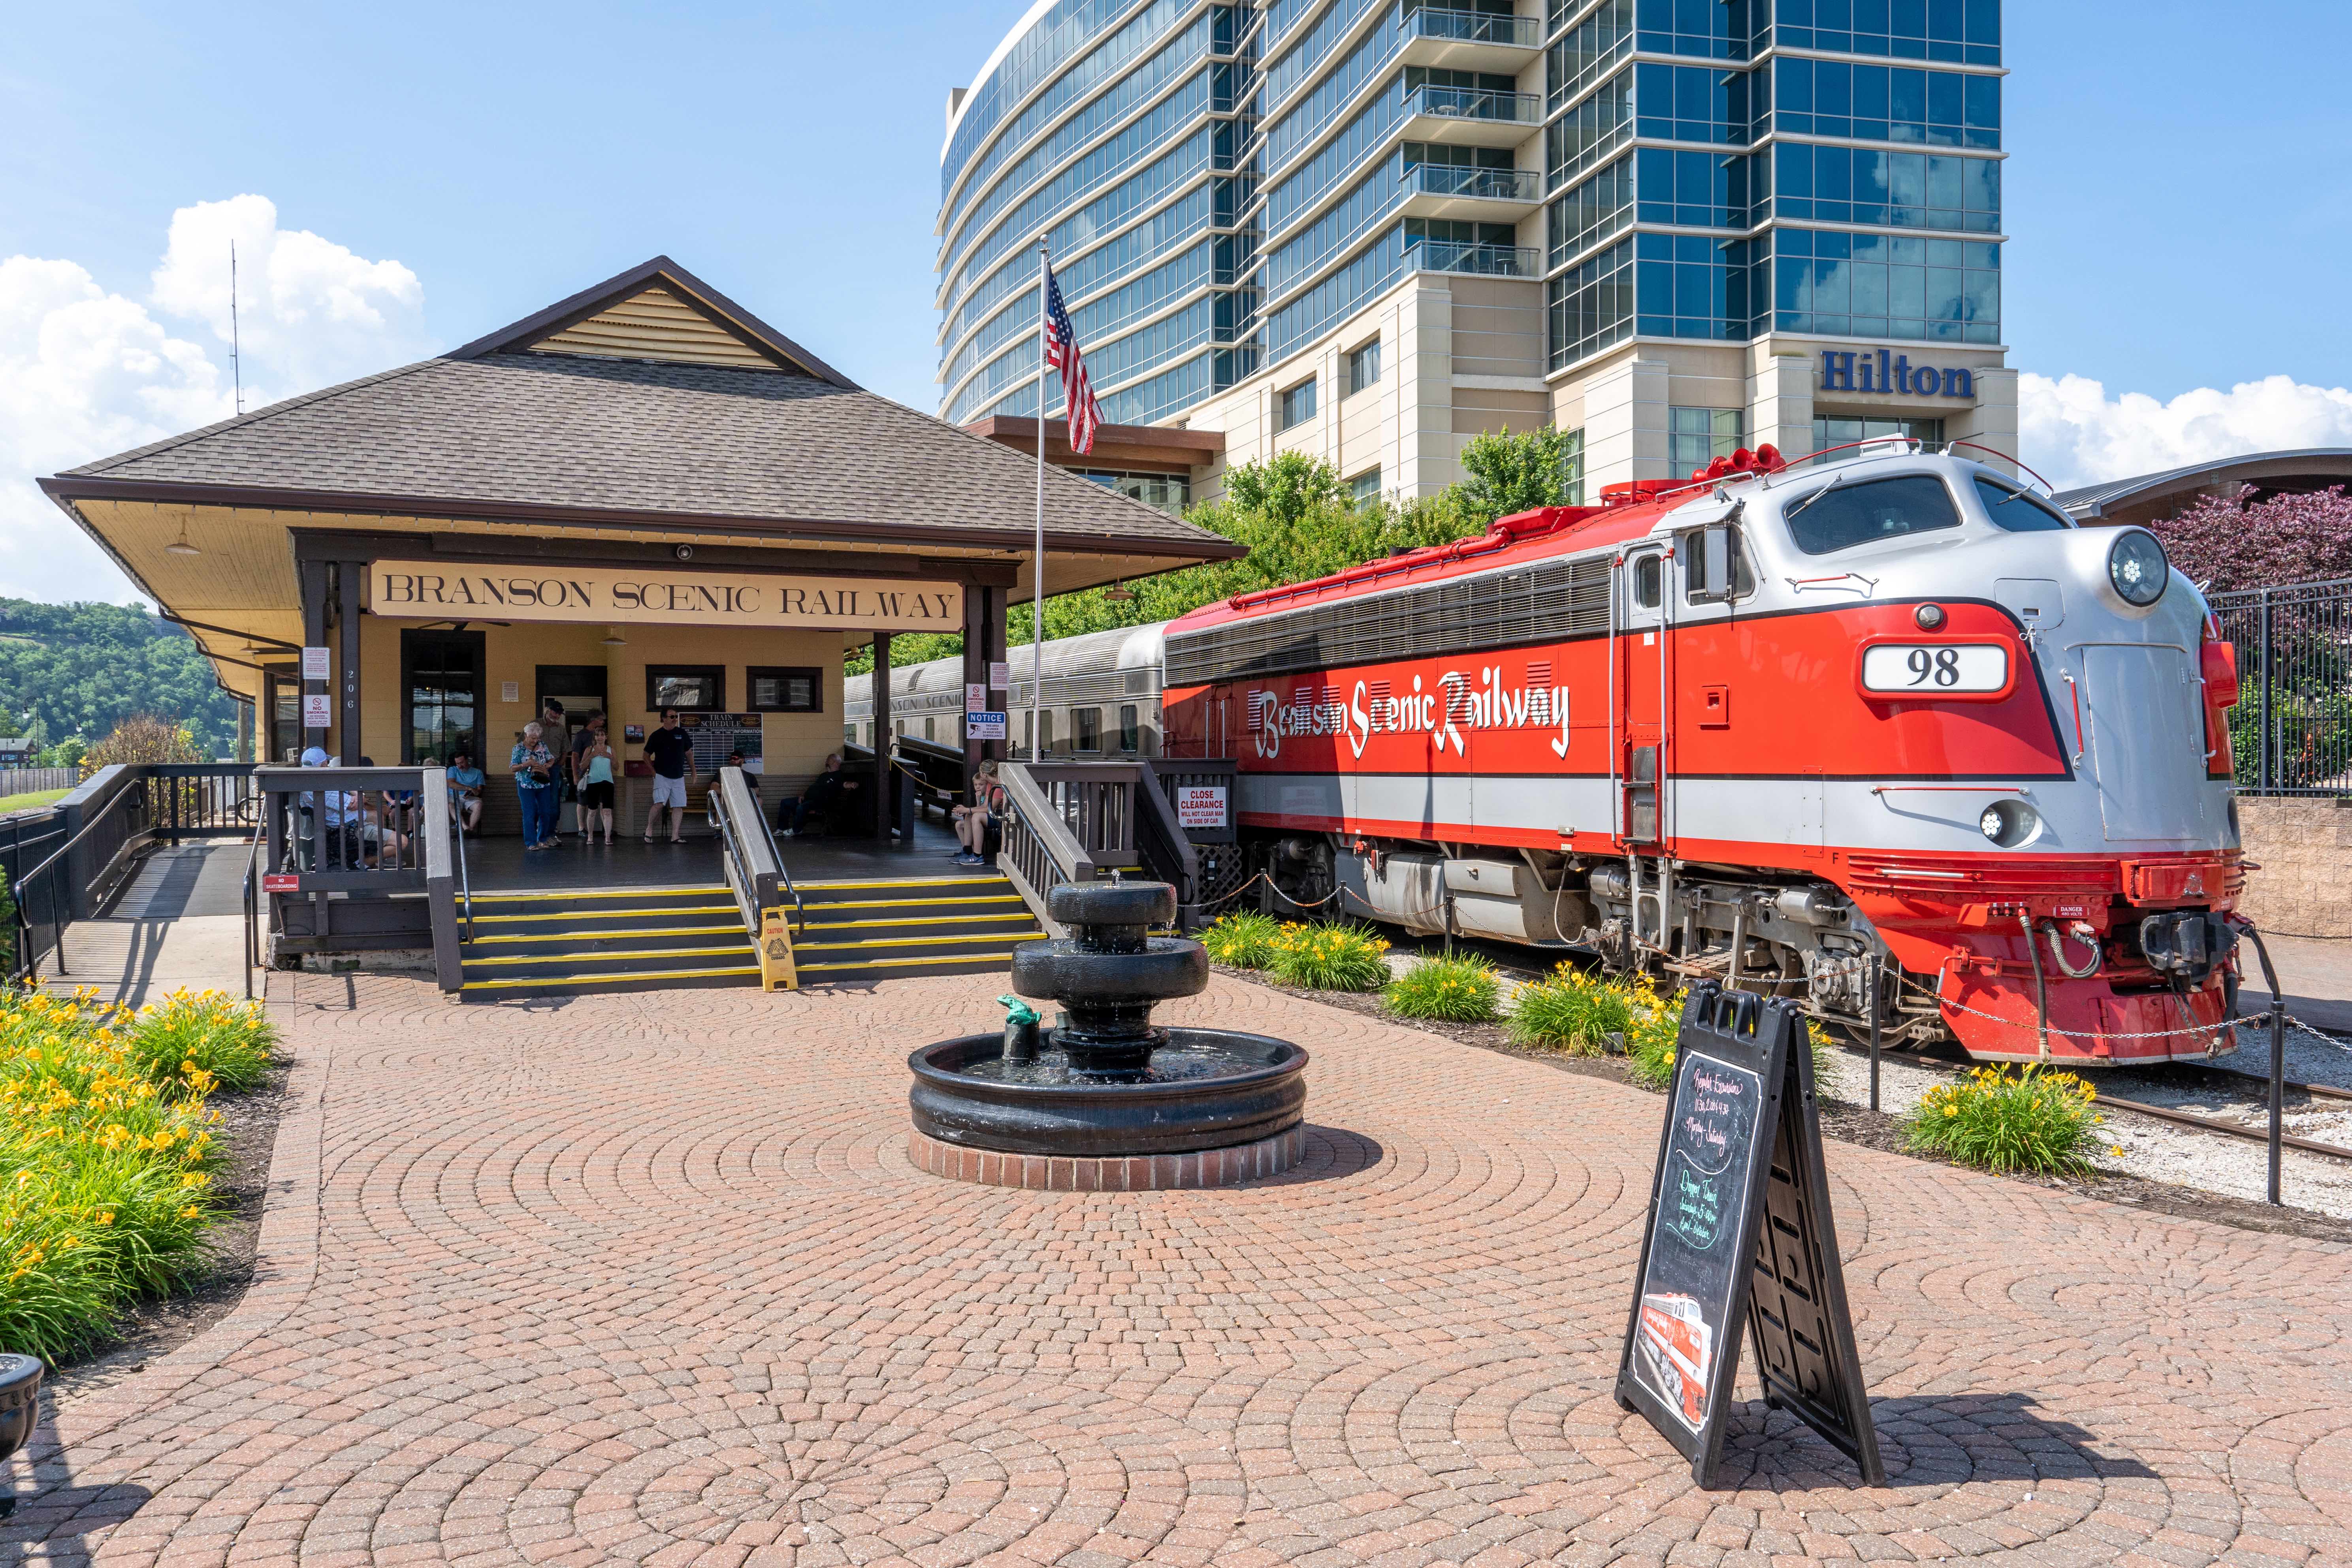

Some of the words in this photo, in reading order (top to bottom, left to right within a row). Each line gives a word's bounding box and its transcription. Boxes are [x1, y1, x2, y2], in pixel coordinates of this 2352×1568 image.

[1821, 349, 1975, 398] Hilton
[382, 574, 595, 608] BRANSON
[612, 582, 761, 613] SCENIC
[779, 588, 956, 619] RAILWAY
[1907, 649, 1960, 686] 98
[889, 699, 917, 711] NSON
[926, 694, 964, 708] SCENIC
[1255, 691, 1348, 759] Branson
[1348, 674, 1436, 759] Scenic
[1435, 665, 1569, 758] Railway
[1181, 800, 1224, 809] CLEARANCE
[1190, 791, 1214, 799] CLOSE
[1832, 852, 1839, 864] F
[777, 938, 789, 954] ATTENTION
[1694, 1068, 1712, 1097] Regular
[1714, 1074, 1743, 1095] Excursions
[1680, 1170, 1700, 1197] Dinner
[1702, 1178, 1718, 1209] Train
